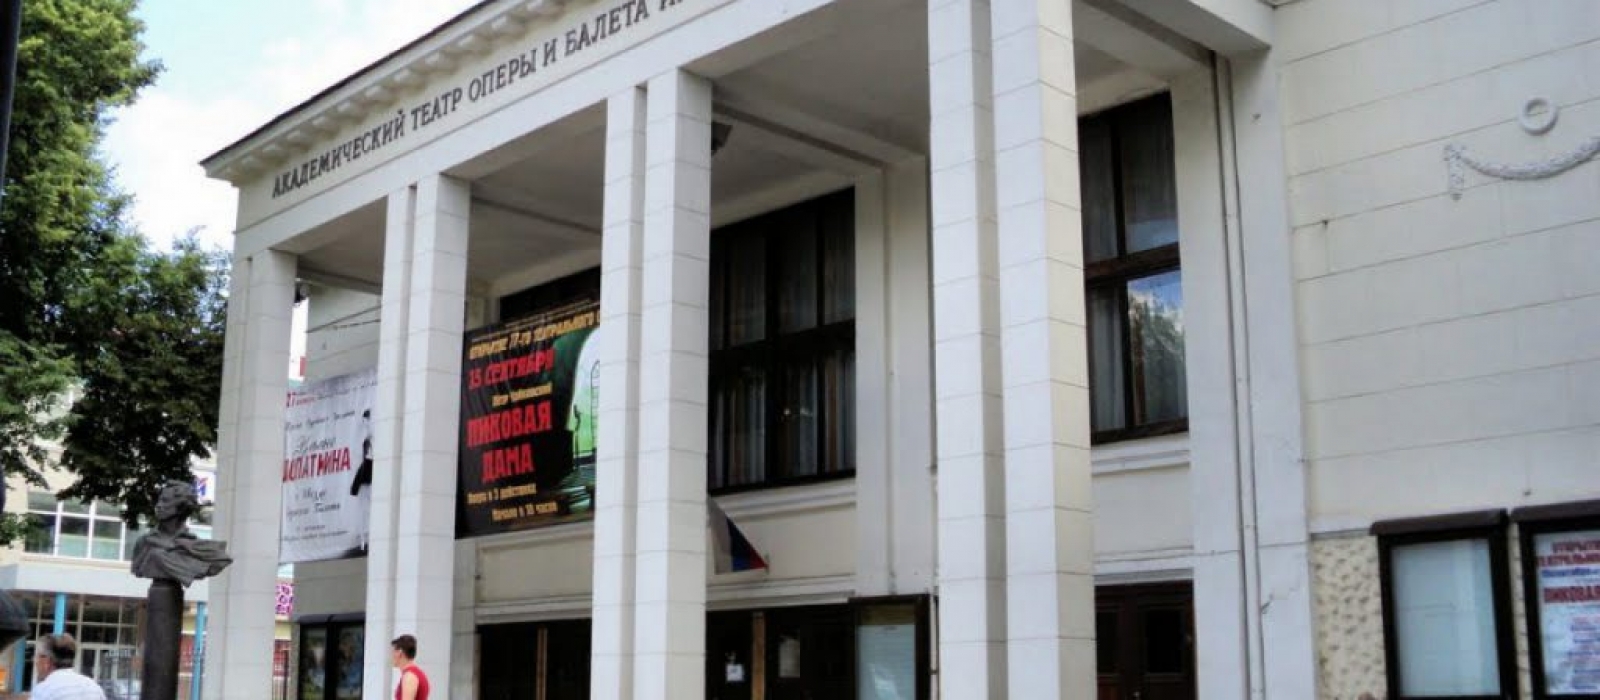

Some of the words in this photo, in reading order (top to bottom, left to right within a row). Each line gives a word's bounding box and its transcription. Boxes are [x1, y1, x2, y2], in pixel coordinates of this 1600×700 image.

[272, 108, 406, 198] АКАДЕМИЧЕСКИЙ
[411, 87, 463, 131] ТЕАТР
[468, 48, 537, 102] ОПЕРЫ
[542, 38, 558, 67] И
[564, 0, 650, 57] БАЛЕТА
[466, 401, 553, 448] ПИКОВАЯ
[482, 444, 534, 483] ДАМА
